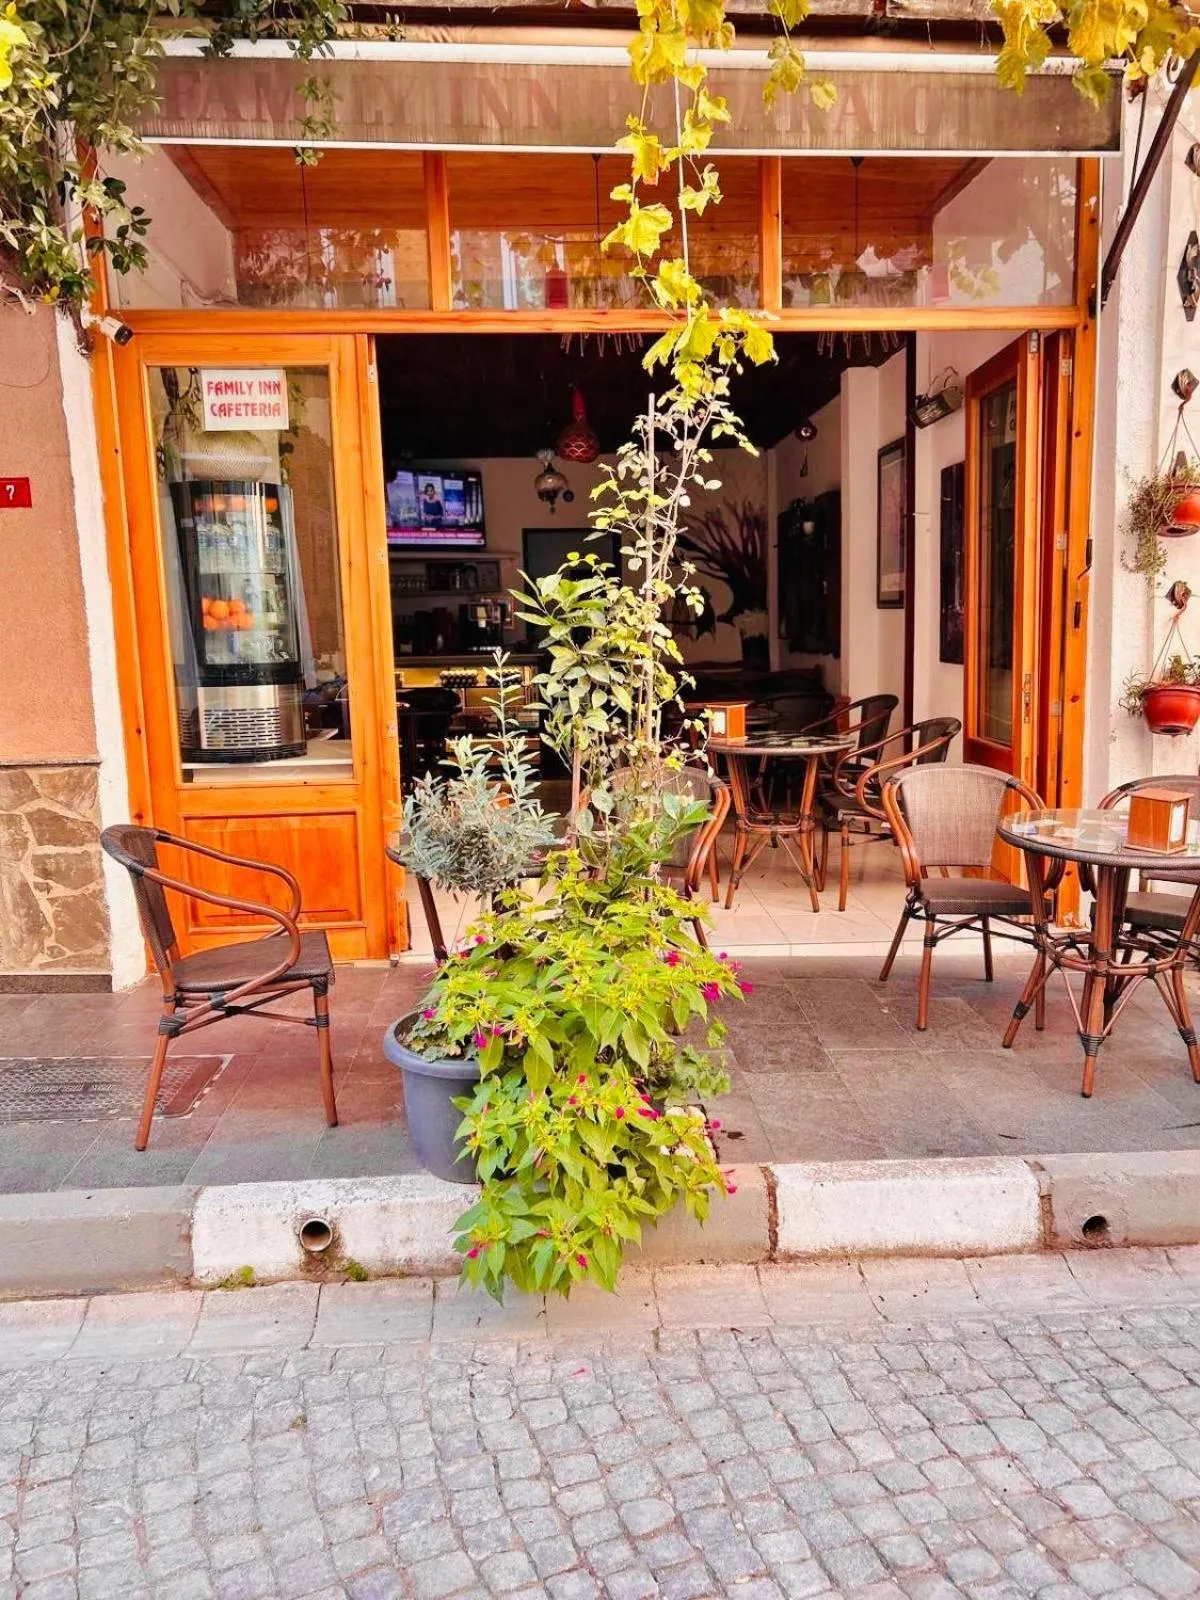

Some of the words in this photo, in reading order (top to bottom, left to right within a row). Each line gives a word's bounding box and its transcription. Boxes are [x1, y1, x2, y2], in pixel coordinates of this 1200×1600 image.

[163, 69, 420, 126] FAMLY
[447, 76, 564, 131] INN
[206, 380, 253, 396] FAMILY
[258, 380, 282, 396] INN
[209, 402, 282, 418] CAFETERIA
